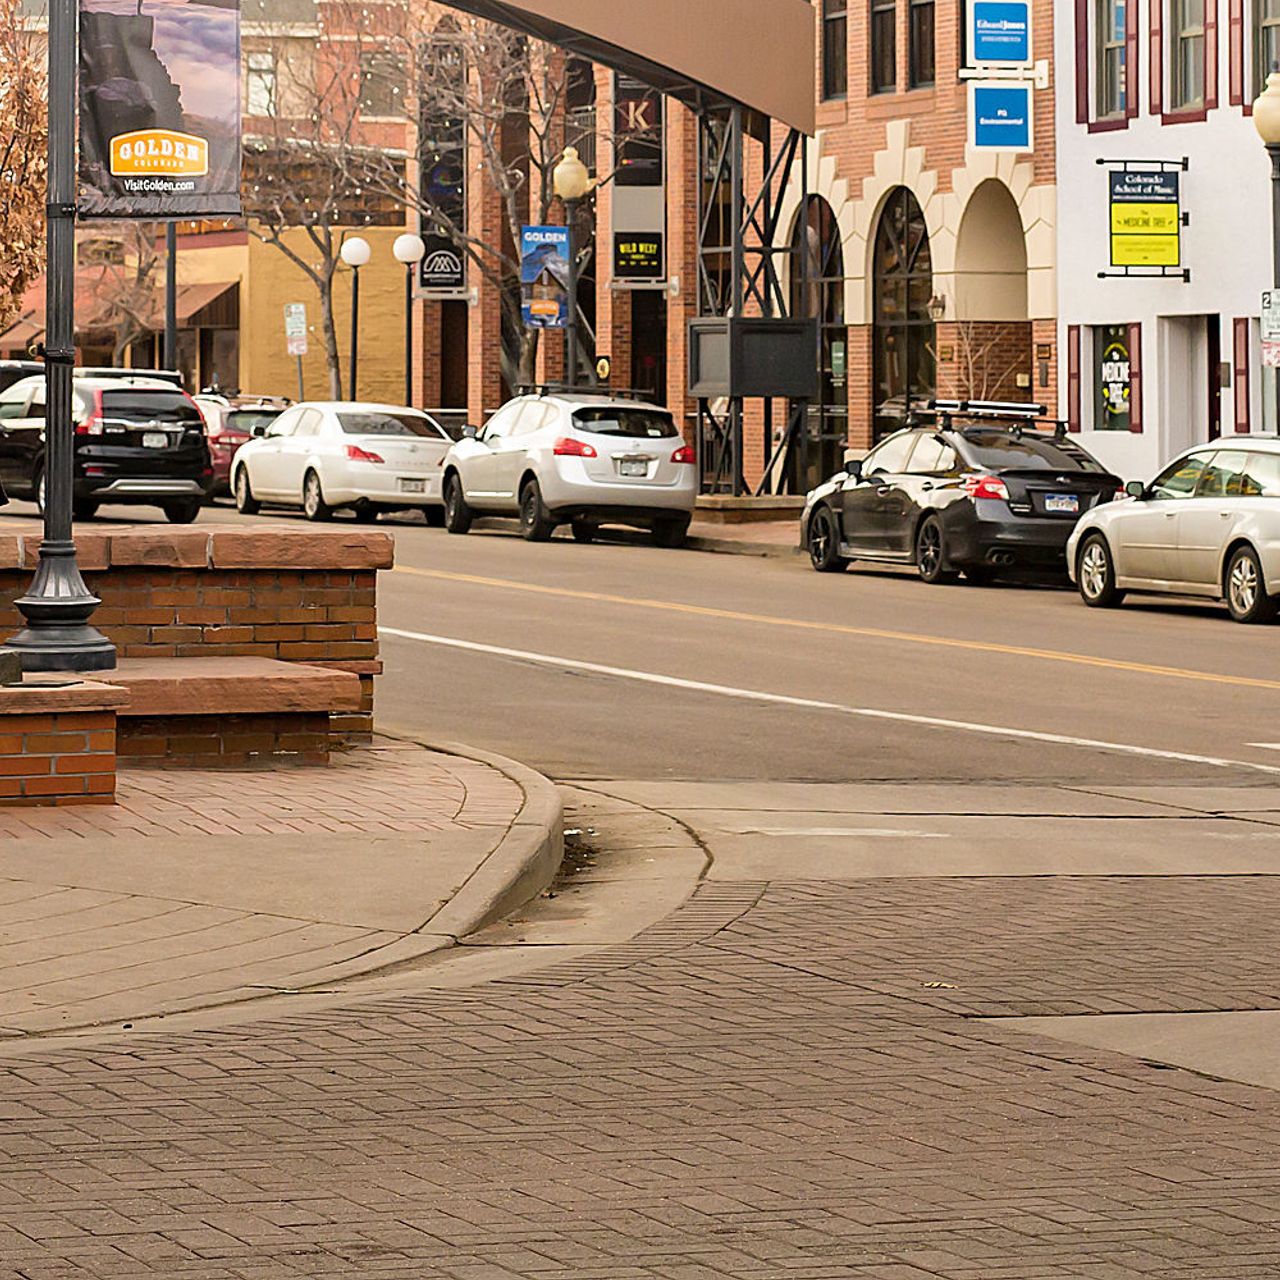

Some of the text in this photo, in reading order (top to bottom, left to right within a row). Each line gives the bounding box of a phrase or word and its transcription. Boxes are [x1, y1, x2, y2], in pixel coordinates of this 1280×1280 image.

[628, 101, 649, 129] K
[120, 139, 200, 161] GOLDEN
[124, 179, 195, 191] VisitGolden.com
[524, 232, 567, 242] GOLDEN
